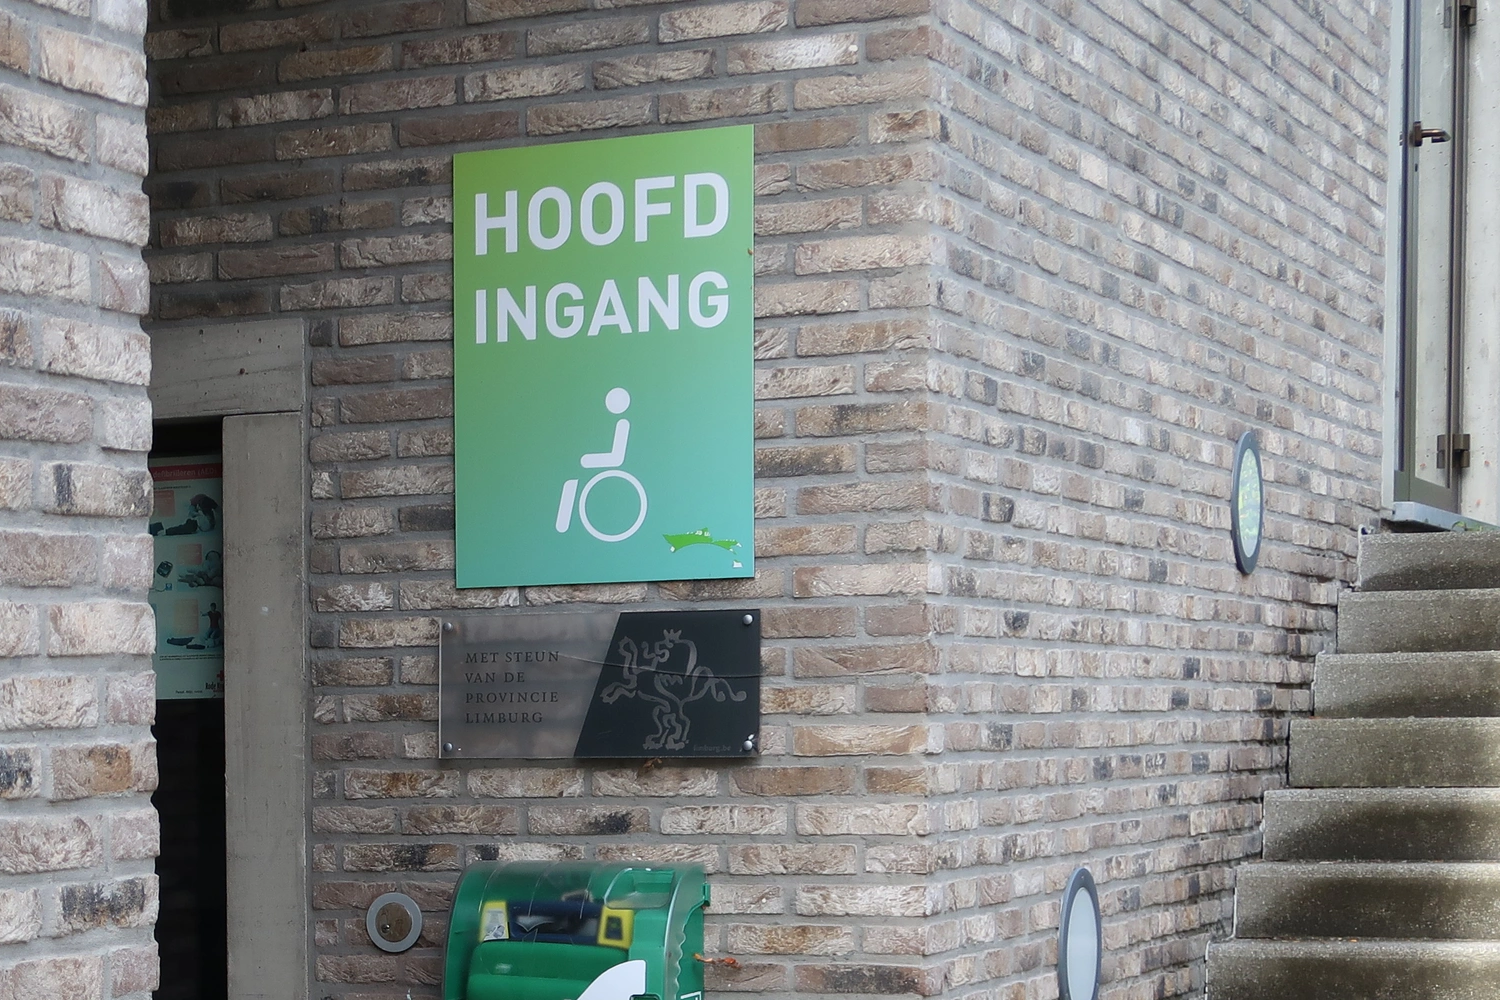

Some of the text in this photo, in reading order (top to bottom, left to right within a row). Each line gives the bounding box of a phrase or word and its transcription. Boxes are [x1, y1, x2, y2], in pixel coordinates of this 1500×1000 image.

[475, 172, 729, 255] HOOFD
[475, 271, 729, 344] INGANG
[465, 651, 560, 663] MET STEUN
[465, 672, 525, 683] VAN DE
[465, 692, 559, 703] PROVINCIE
[465, 712, 543, 723] LIMBURG
